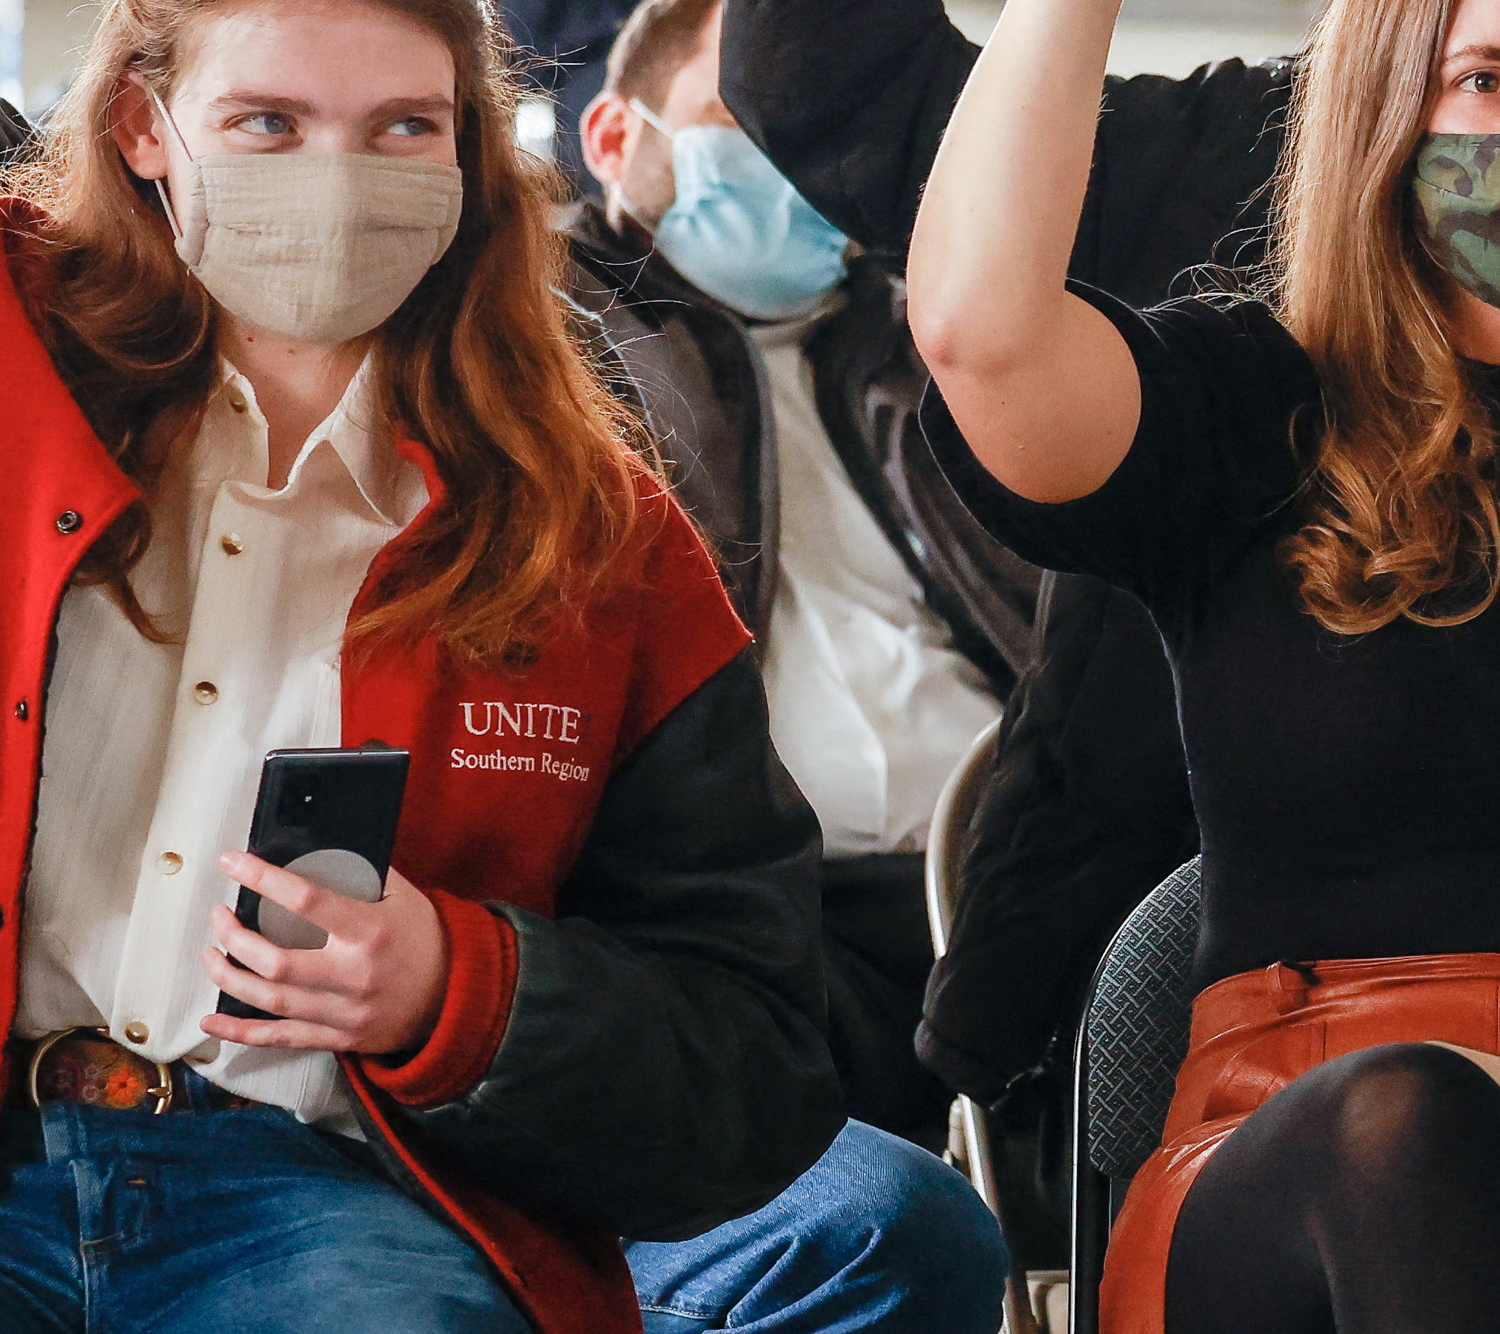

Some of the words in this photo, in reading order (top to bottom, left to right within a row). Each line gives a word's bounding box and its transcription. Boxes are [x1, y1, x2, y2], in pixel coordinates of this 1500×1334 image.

[459, 701, 582, 744] UNITE
[450, 748, 536, 772] Southern
[540, 752, 591, 782] Region
